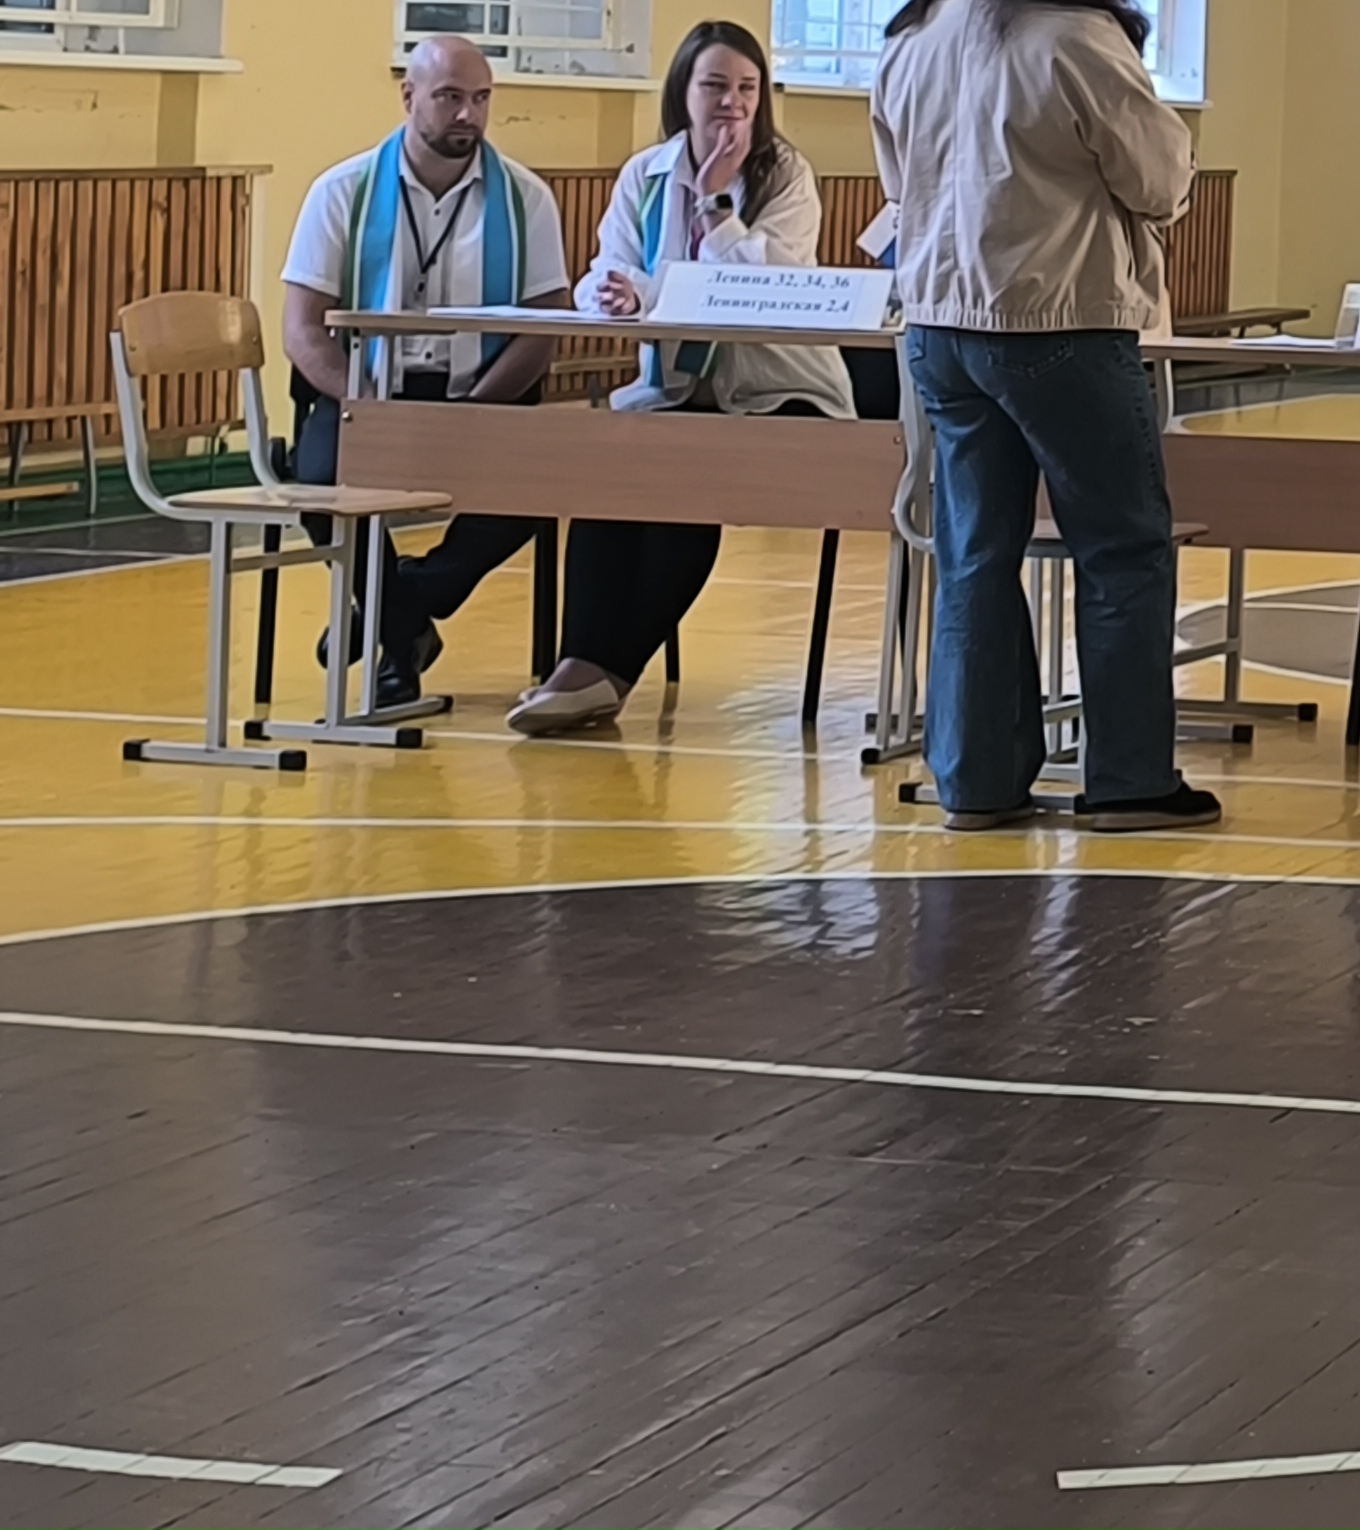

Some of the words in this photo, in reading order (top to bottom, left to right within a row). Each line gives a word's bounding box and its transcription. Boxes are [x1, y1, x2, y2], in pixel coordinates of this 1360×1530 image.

[707, 270, 771, 287] Ленина
[773, 273, 798, 288] 32,
[802, 273, 827, 289] 34,
[829, 274, 850, 289] 36
[701, 295, 822, 313] Ленинградская
